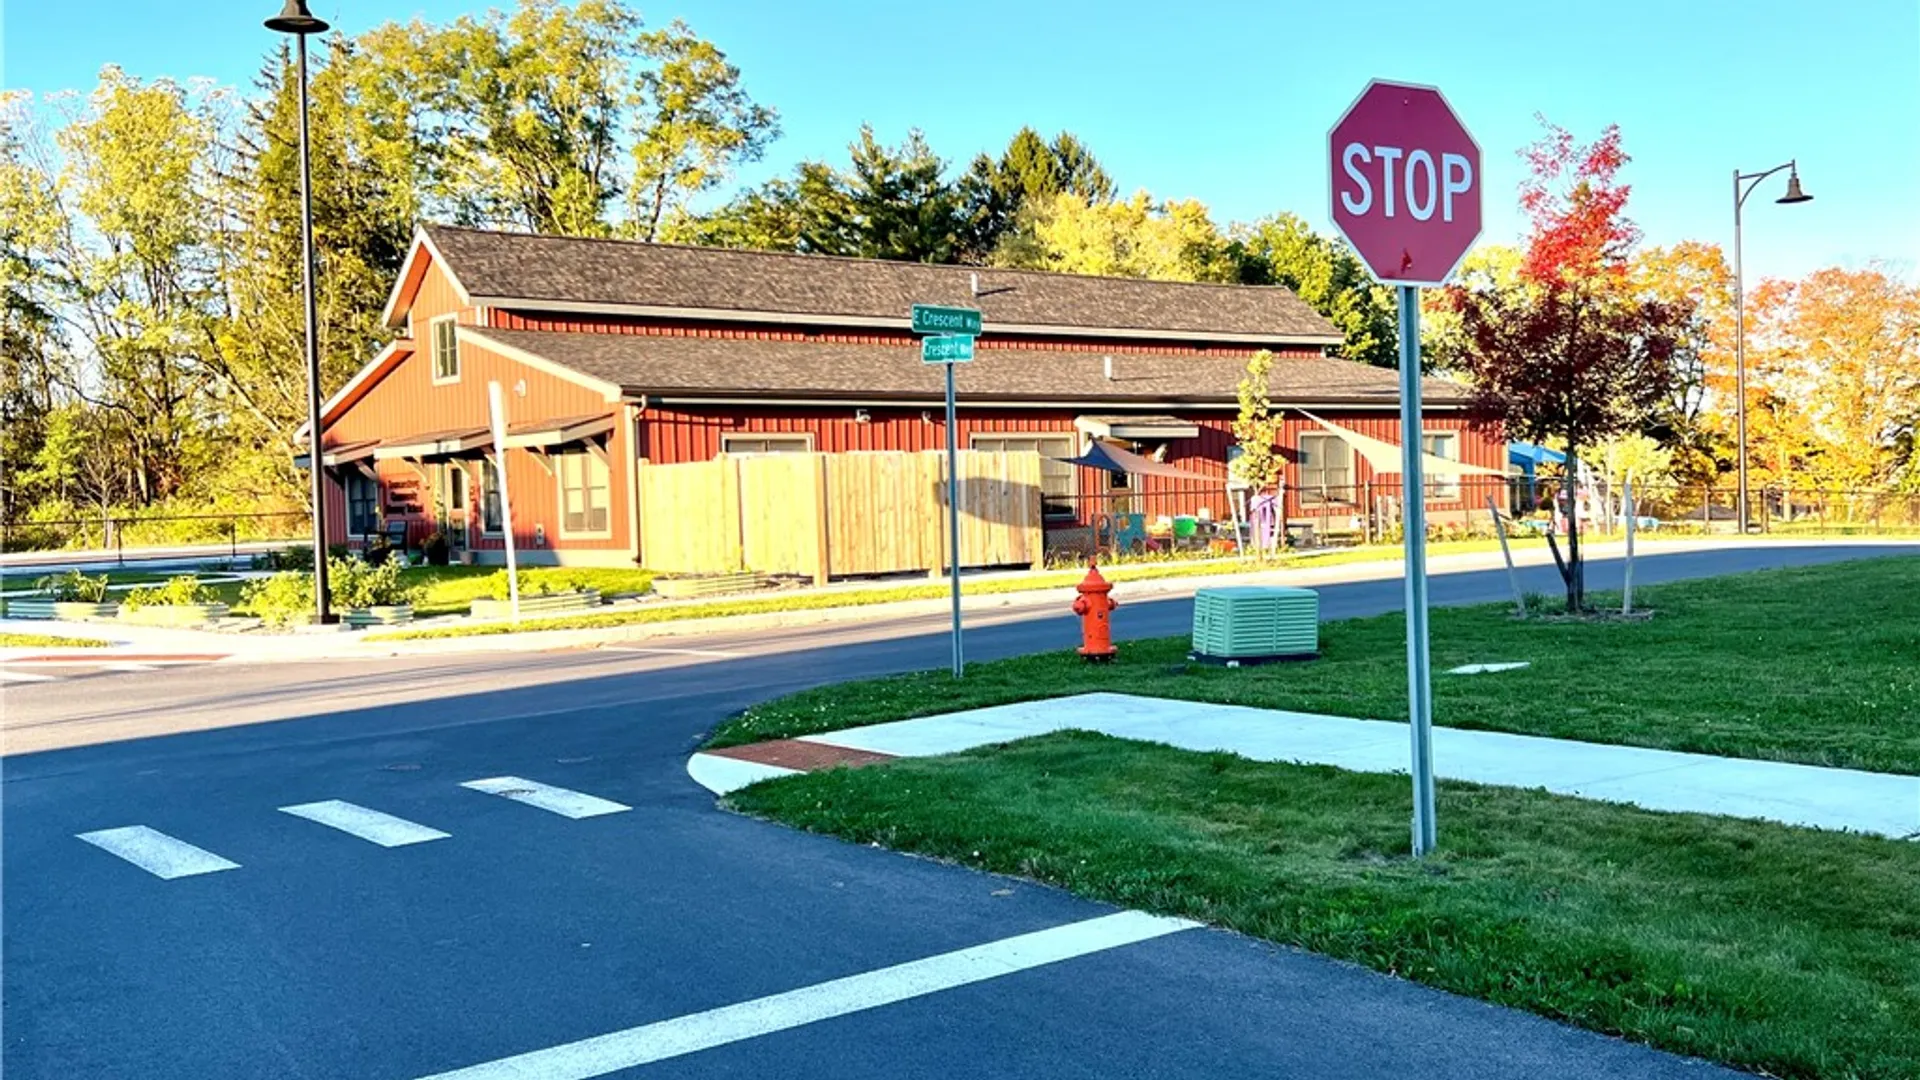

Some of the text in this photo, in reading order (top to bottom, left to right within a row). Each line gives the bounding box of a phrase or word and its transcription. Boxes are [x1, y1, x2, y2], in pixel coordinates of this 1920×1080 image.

[1341, 142, 1472, 222] STOP
[914, 309, 920, 325] E
[922, 310, 963, 327] Crescent
[924, 341, 958, 356] Crescent
